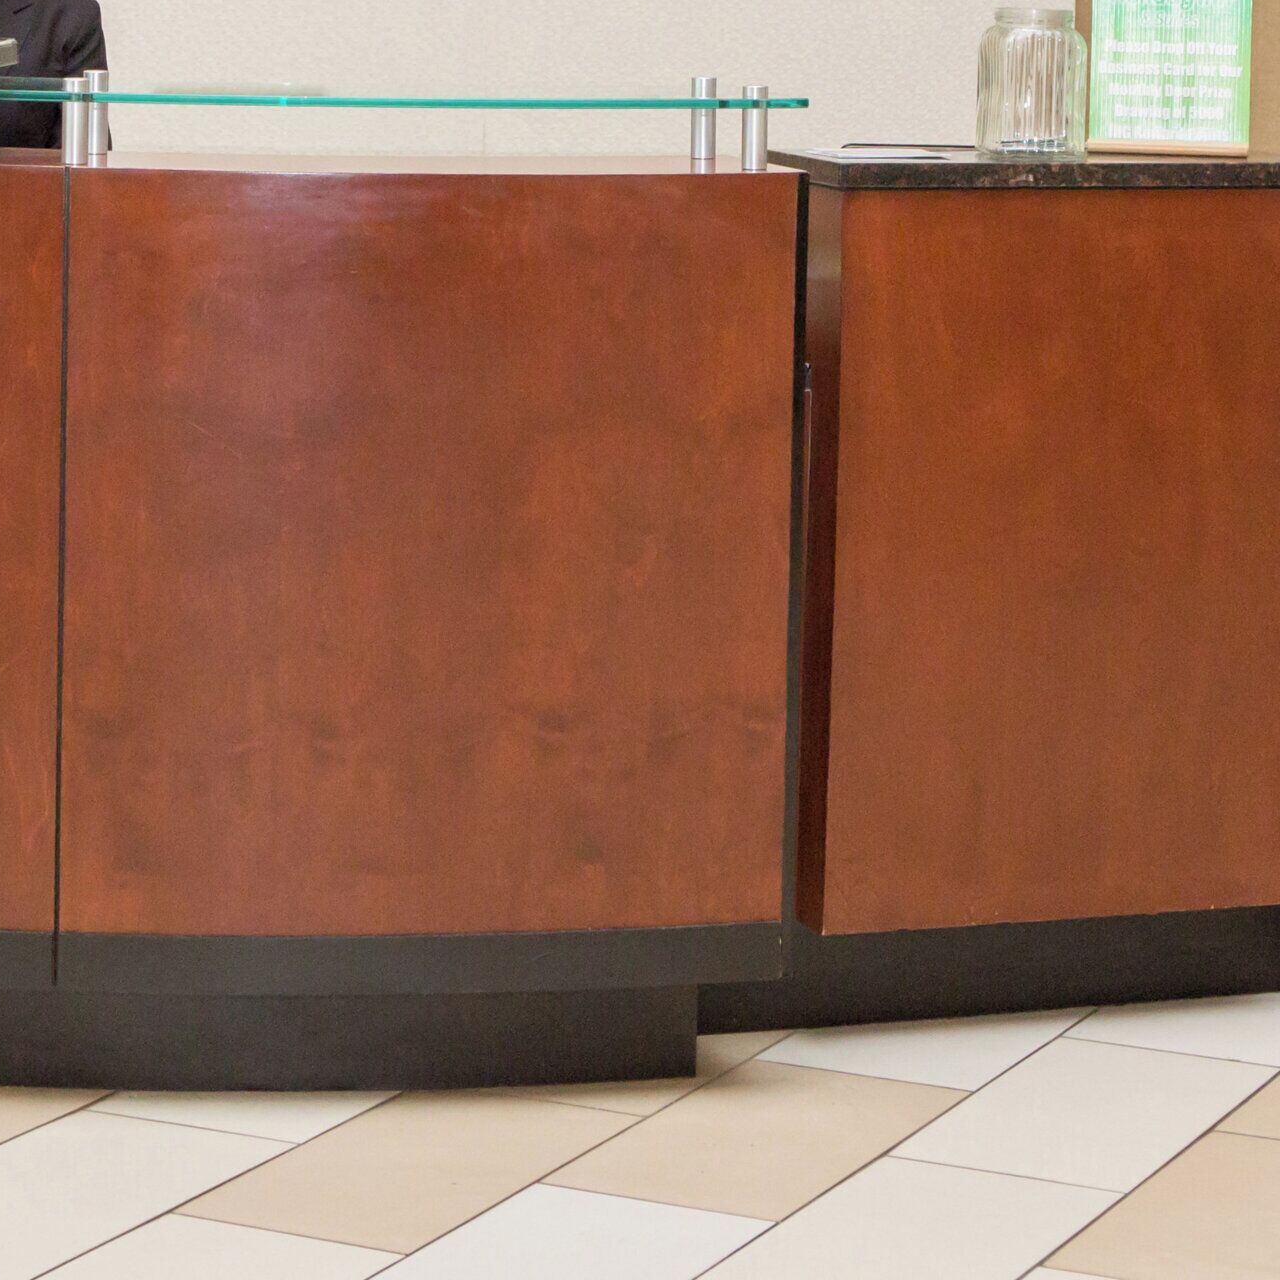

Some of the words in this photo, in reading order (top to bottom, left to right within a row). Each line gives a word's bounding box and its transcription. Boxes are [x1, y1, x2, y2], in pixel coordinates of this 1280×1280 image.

[1104, 38, 1152, 54] Please
[1152, 41, 1186, 57] Drop
[1207, 42, 1240, 57] Your
[1098, 59, 1161, 76] Business
[1162, 62, 1195, 77] Card
[1198, 84, 1233, 99] Prize
